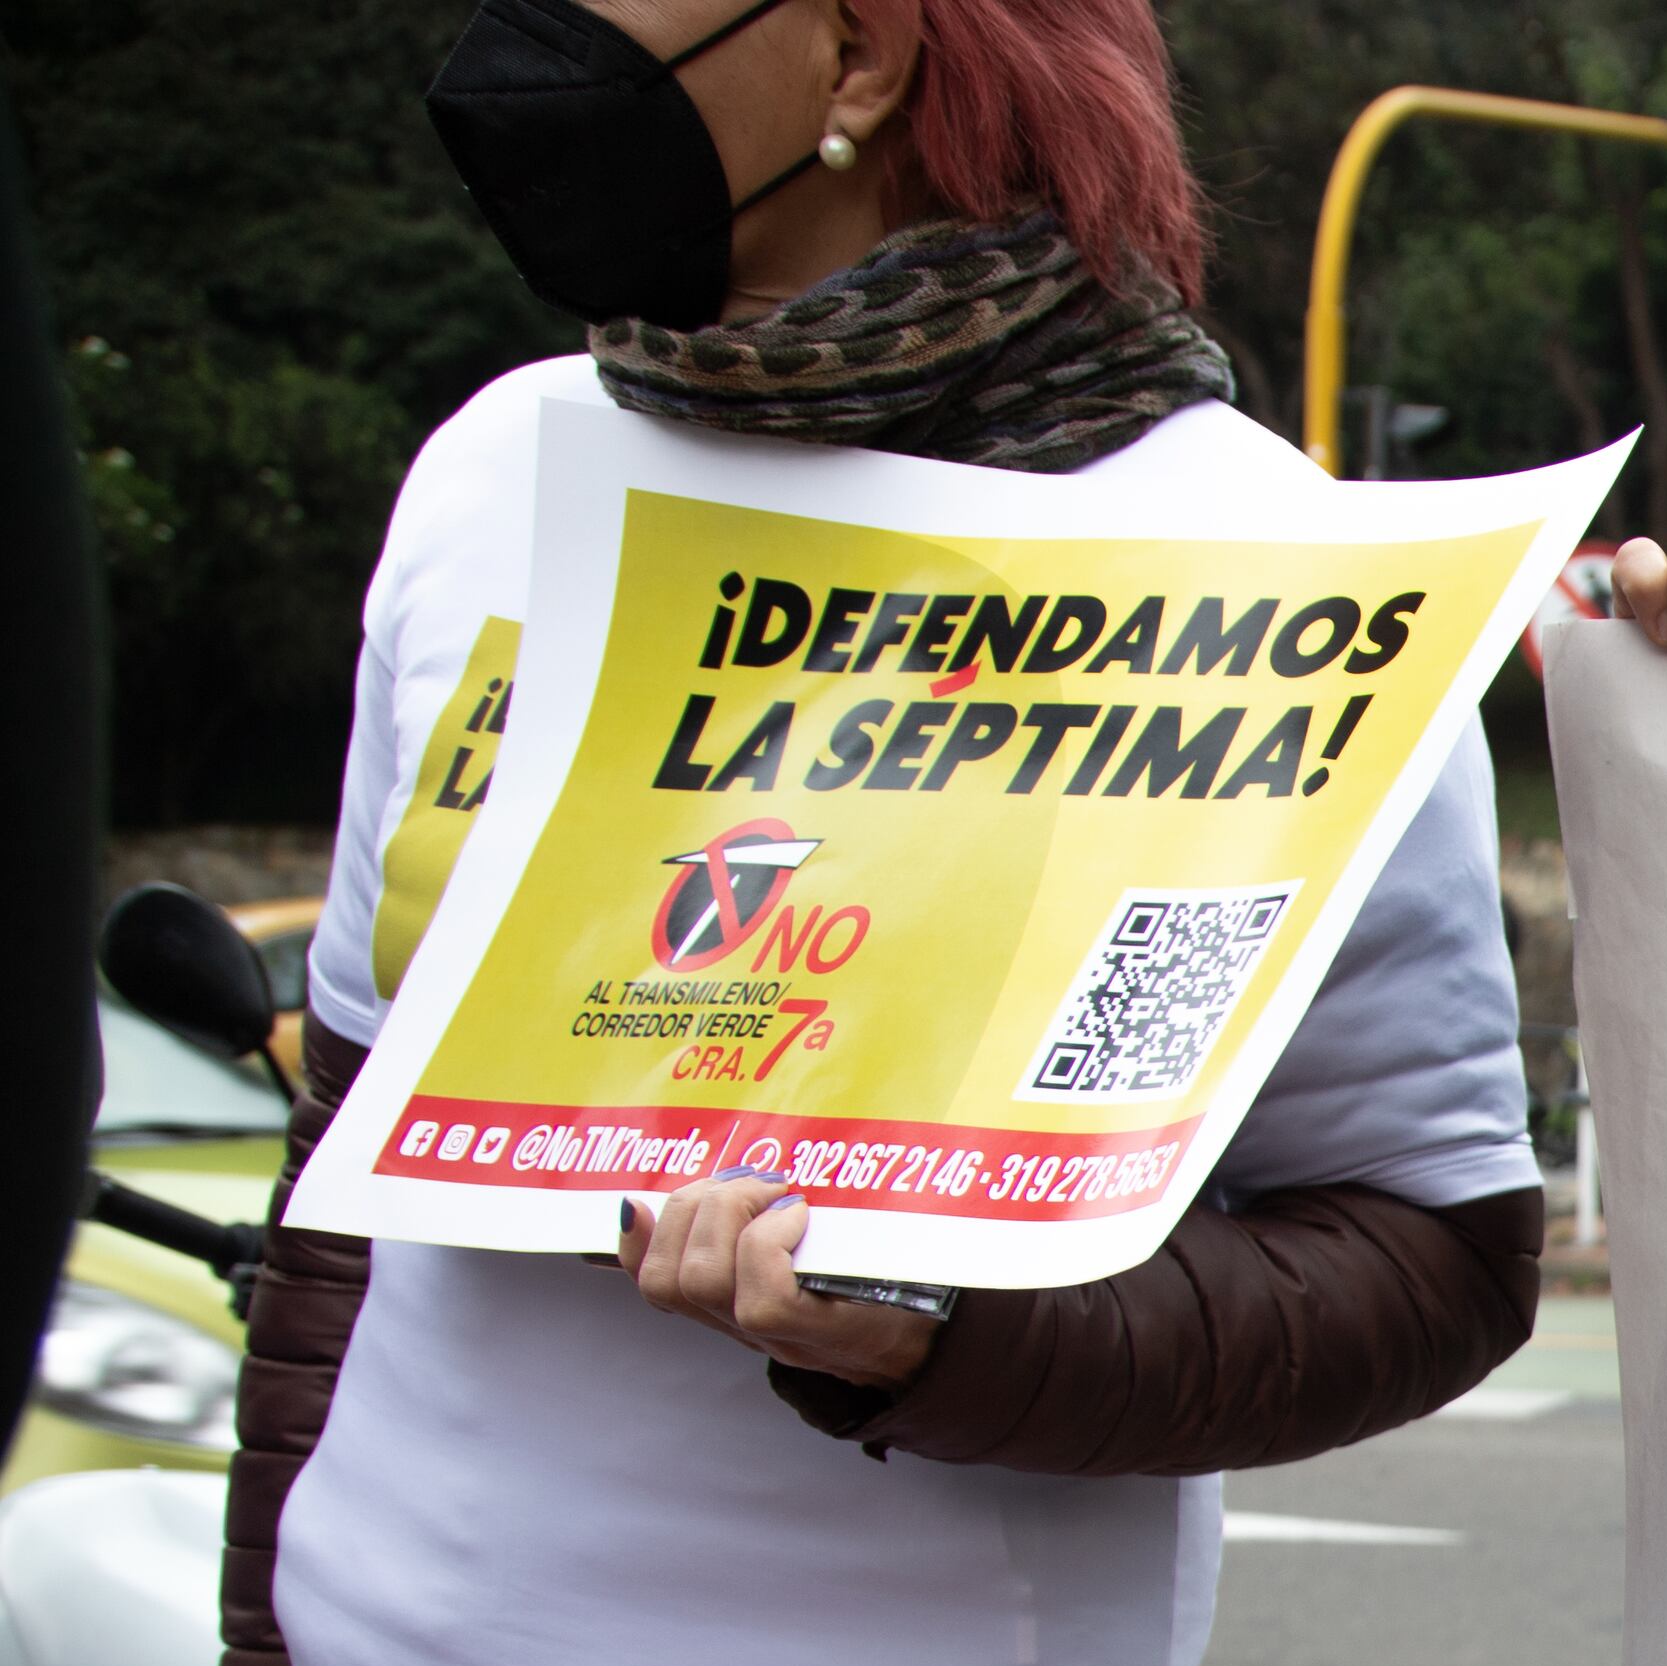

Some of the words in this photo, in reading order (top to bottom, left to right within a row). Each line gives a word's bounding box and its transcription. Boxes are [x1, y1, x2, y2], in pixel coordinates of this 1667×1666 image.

[698, 571, 1426, 677] ¡DEFENDAMOS
[652, 694, 795, 791] LA
[805, 659, 1374, 799] SÉPTIMA!
[752, 906, 870, 974] NO
[584, 981, 612, 1004] AL
[619, 982, 792, 1006] TRANSMILENIO/
[572, 1012, 693, 1038] CORREDOR
[696, 1013, 773, 1038] VERDE
[672, 1046, 744, 1080] CRA.
[513, 1125, 709, 1176] @NoTM7verde
[784, 1140, 842, 1187] 302
[836, 1143, 898, 1189] 667
[891, 1146, 983, 1196] 2146
[989, 1154, 1061, 1201] 319
[1050, 1150, 1112, 1202] 278
[1105, 1142, 1179, 1199] 5653
